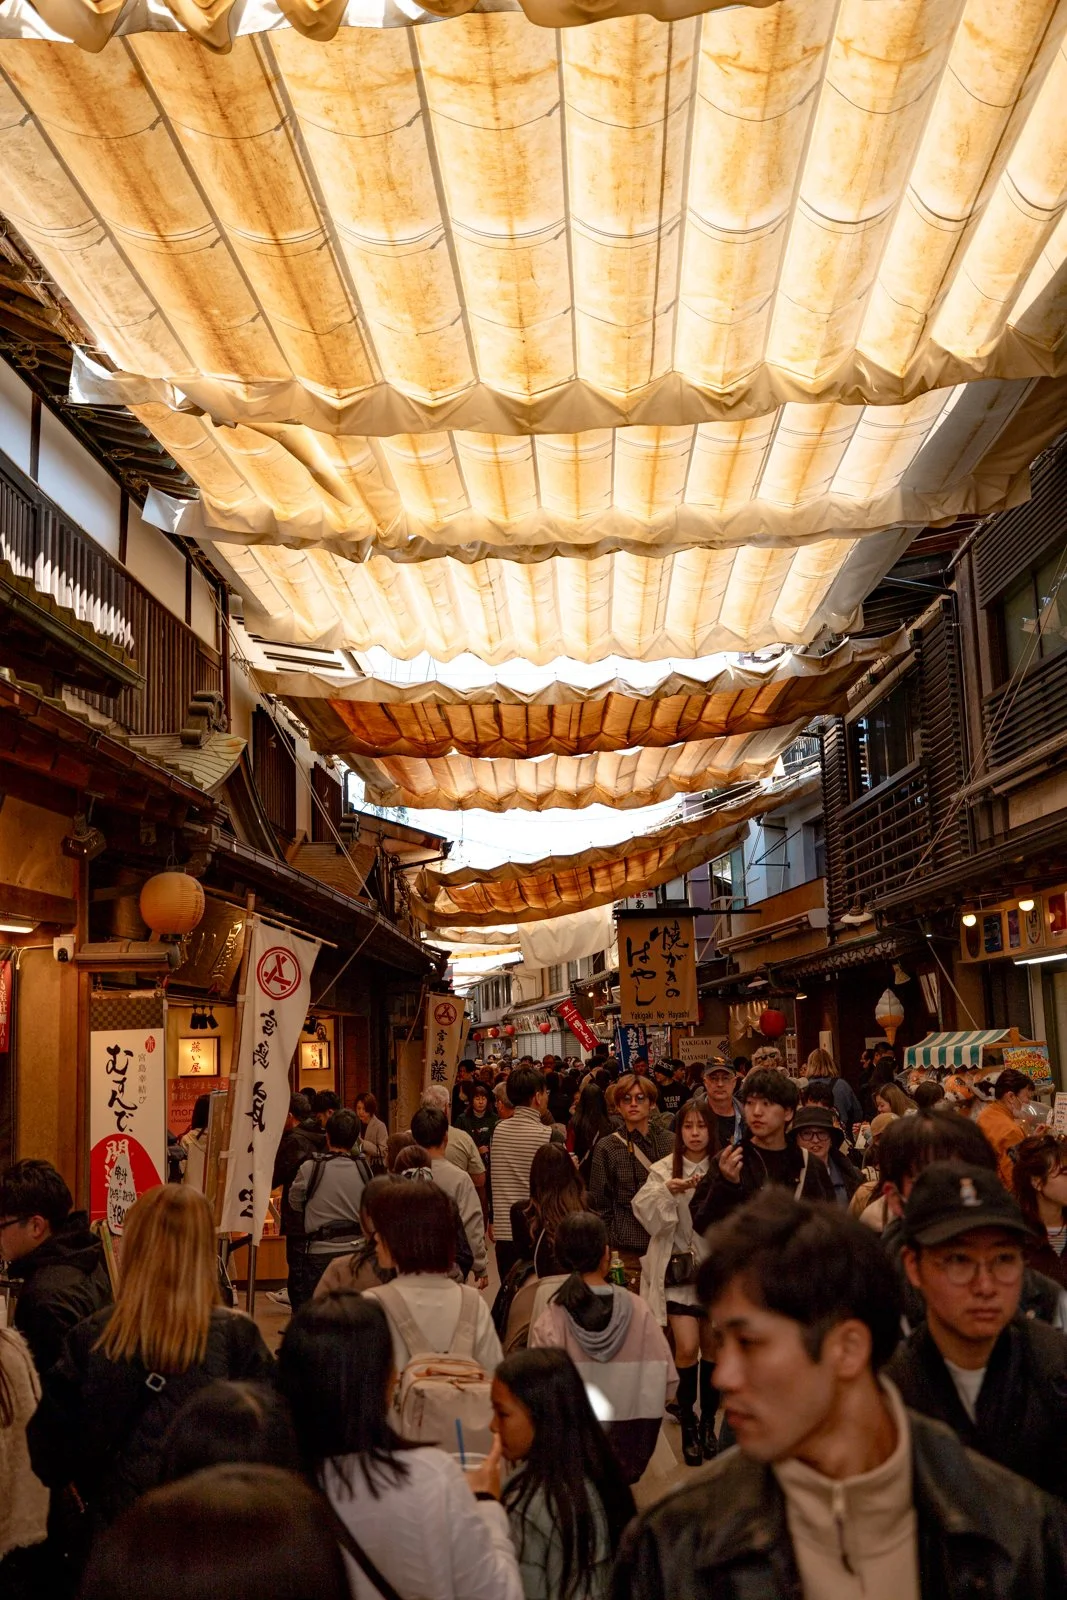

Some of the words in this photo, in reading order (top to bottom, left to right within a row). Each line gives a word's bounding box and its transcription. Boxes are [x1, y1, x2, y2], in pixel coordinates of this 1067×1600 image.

[626, 936, 657, 1007] はやし
[630, 1010, 654, 1020] Yakigaki
[656, 1010, 665, 1018] No
[668, 1009, 690, 1020] Hayashi
